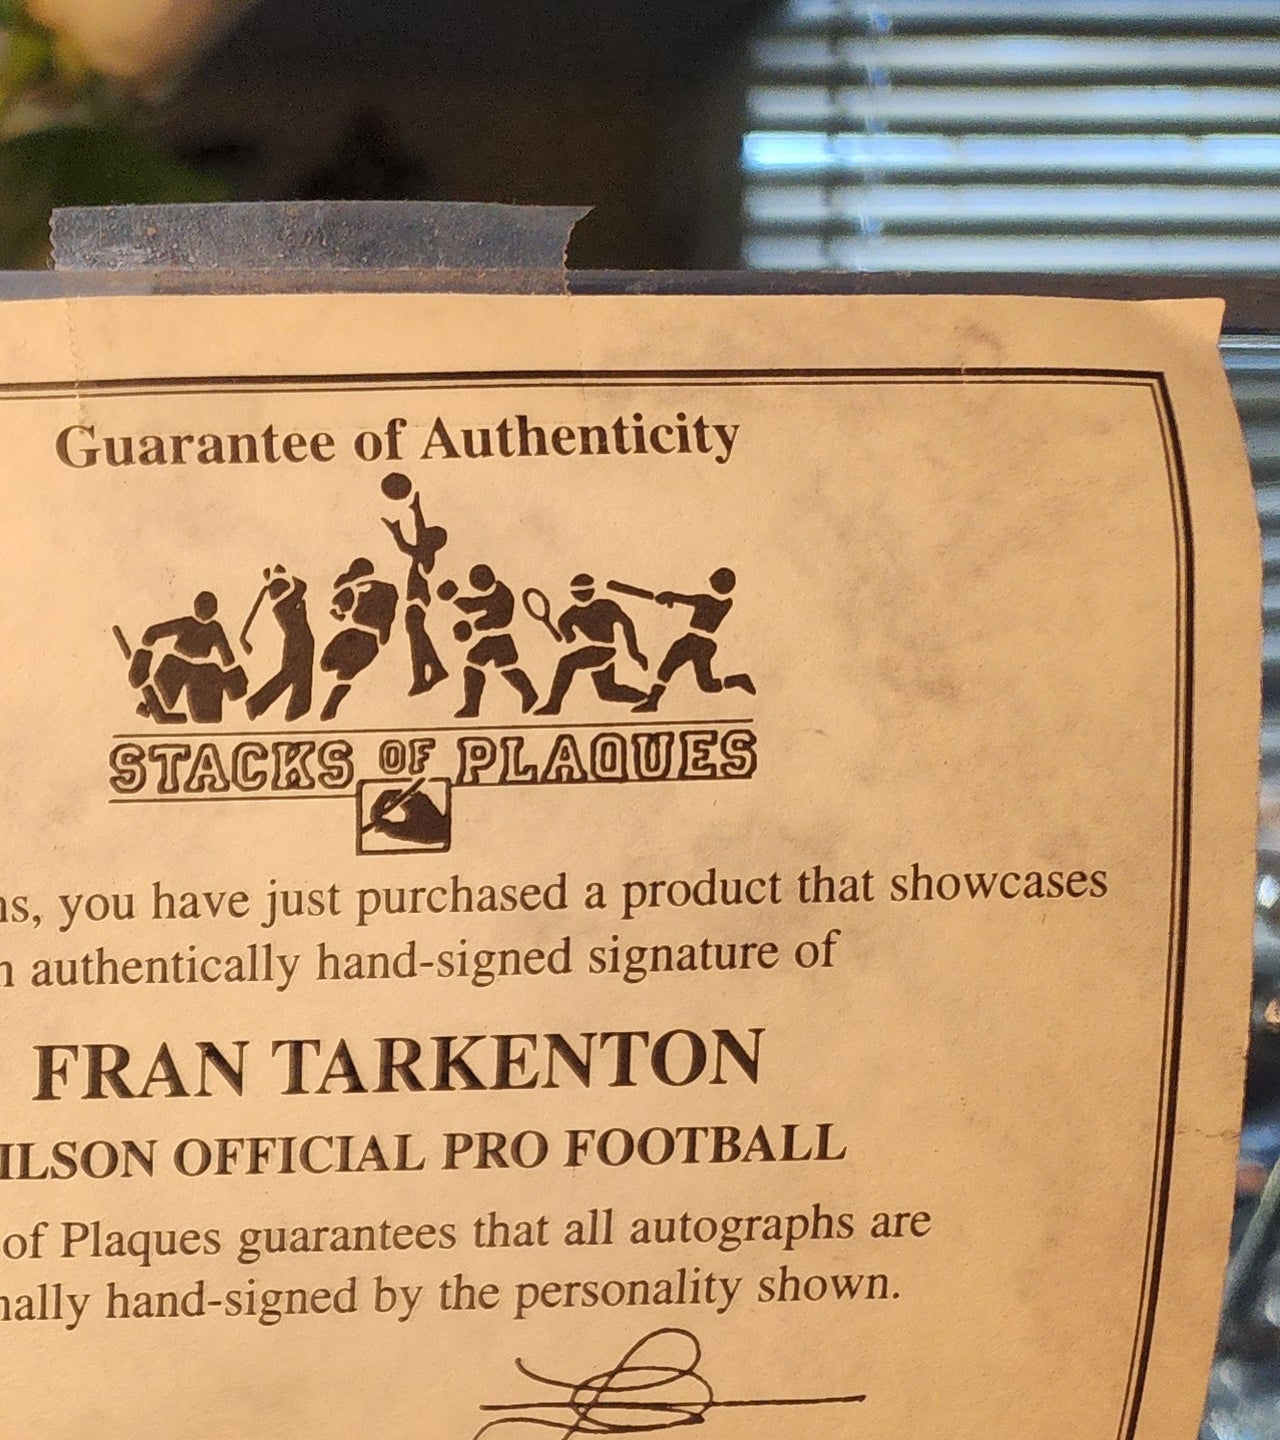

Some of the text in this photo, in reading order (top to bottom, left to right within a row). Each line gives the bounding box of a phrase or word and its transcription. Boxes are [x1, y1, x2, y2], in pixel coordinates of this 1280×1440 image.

[55, 411, 741, 469] Guarantee of Authenticity
[109, 726, 757, 795] STACKS OF PLAQUES
[58, 893, 136, 933] you
[151, 881, 250, 920] have
[260, 878, 341, 929] just
[355, 871, 569, 927] purchased
[584, 882, 607, 910] a
[621, 867, 783, 920] product
[797, 864, 875, 904] that
[890, 862, 1108, 902] showcases
[31, 942, 301, 992] authentically
[316, 935, 573, 988] hand-signed
[589, 934, 780, 984] signature
[794, 928, 842, 969] of
[31, 1027, 766, 1101] FRAN TARKENTON
[173, 1133, 426, 1177] OFFICIAL
[441, 1129, 549, 1170] PRO
[563, 1122, 847, 1168] FOOTBALL
[2, 1221, 50, 1260] of
[60, 1220, 222, 1268] Plaques
[236, 1219, 457, 1265] guarantees
[473, 1211, 550, 1248] that
[564, 1207, 614, 1246] all
[630, 1202, 855, 1253] autographs
[870, 1211, 931, 1239] are
[105, 1276, 358, 1327] hand-signed
[373, 1275, 424, 1323] by
[439, 1273, 500, 1311] the
[513, 1266, 743, 1320] personality
[757, 1264, 900, 1303] shown.
